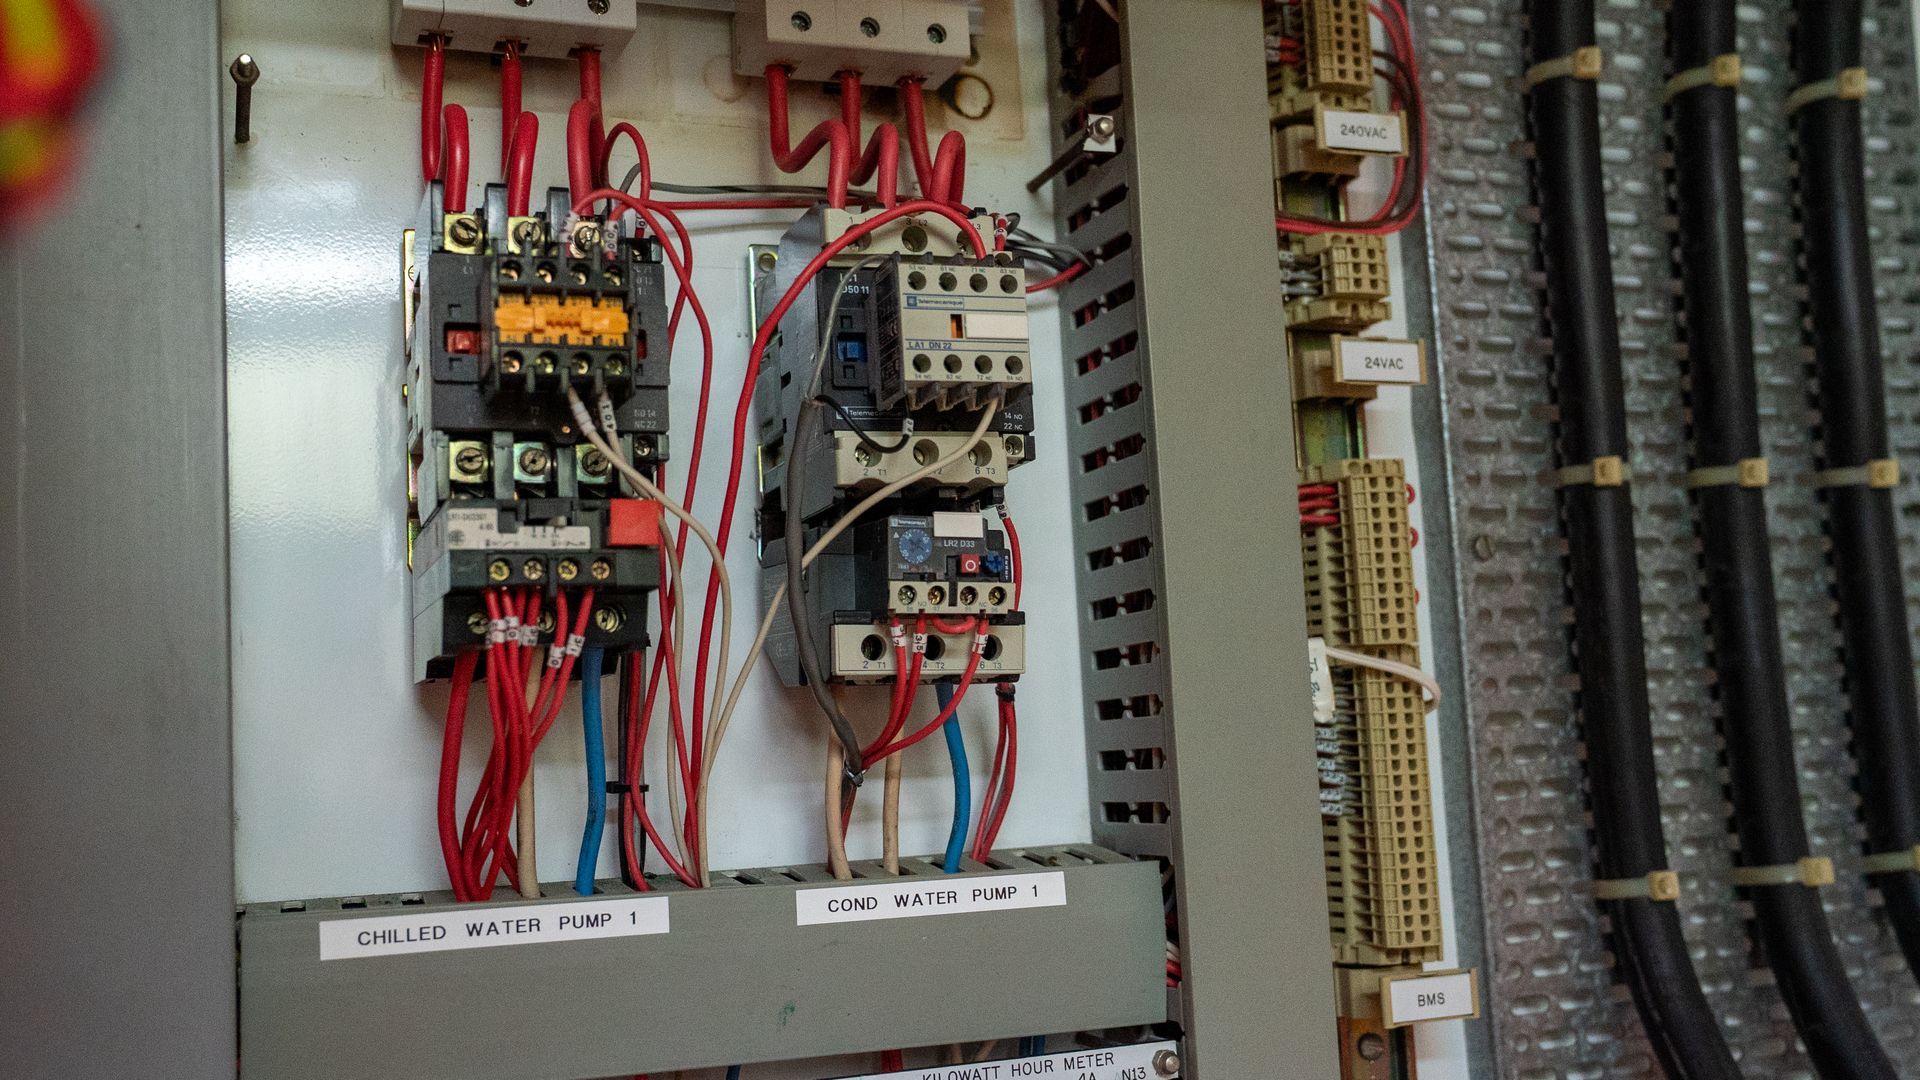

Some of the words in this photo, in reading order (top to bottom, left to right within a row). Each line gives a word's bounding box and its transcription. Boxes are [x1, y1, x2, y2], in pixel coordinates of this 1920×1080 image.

[1340, 123, 1387, 140] 240VAC
[907, 341, 925, 349] LA1
[943, 342, 953, 351] 22
[1364, 357, 1404, 370] 24VAC
[1003, 422, 1013, 430] 22
[974, 466, 981, 475] 6
[986, 467, 996, 475] T3
[960, 540, 976, 548] D33
[862, 661, 869, 669] 2
[922, 660, 928, 669] 4
[979, 660, 985, 669] 6
[828, 896, 878, 912] COND
[894, 890, 958, 908] WATER
[972, 886, 1017, 902] PUMP
[1031, 884, 1038, 897] 1
[357, 925, 447, 946] CHILLED
[466, 918, 541, 937] WATER
[559, 912, 612, 930] PUMP
[629, 911, 638, 925] 1
[1417, 992, 1445, 1007] BMS
[1011, 1060, 1053, 1077] HOUR
[1064, 1052, 1114, 1072] METER
[1121, 1067, 1146, 1080] N13
